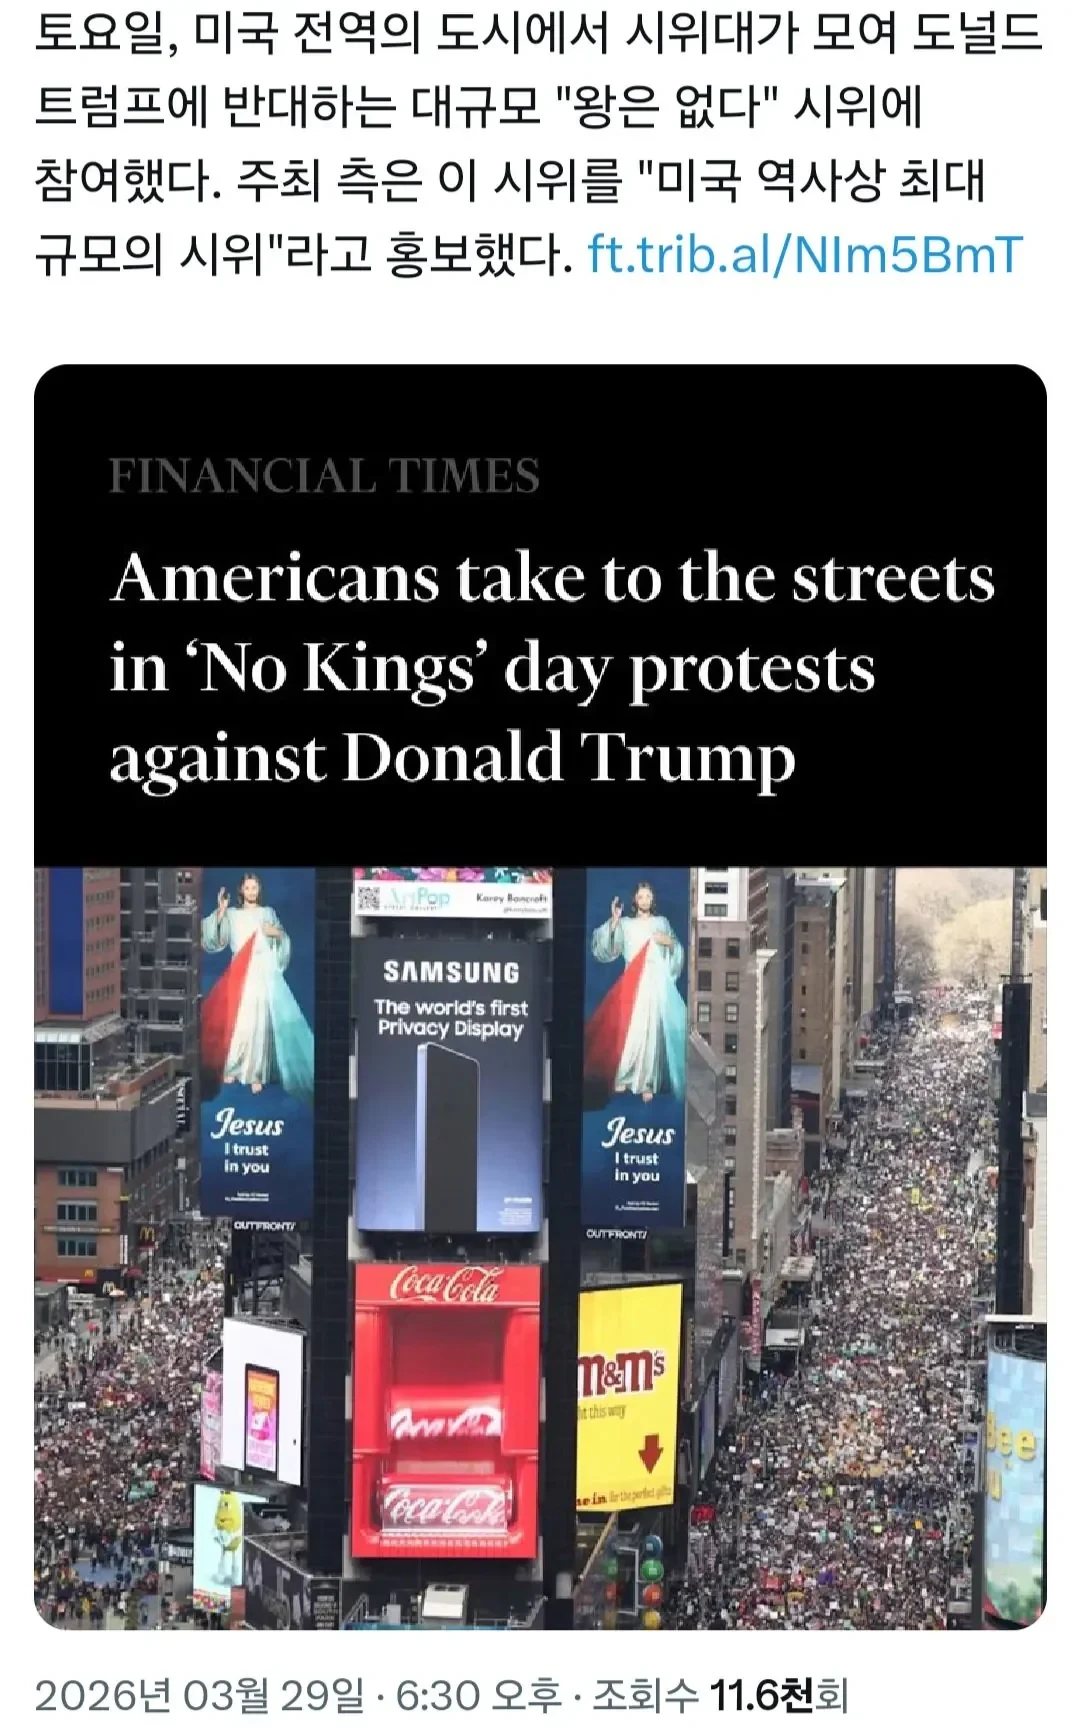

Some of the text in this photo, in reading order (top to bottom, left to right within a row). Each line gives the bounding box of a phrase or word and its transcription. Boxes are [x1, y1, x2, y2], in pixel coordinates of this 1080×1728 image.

[384, 960, 520, 983] SAMSUNG
[374, 999, 529, 1017] The world's first
[378, 1019, 525, 1042] Privacy Display
[210, 1107, 284, 1139] Jesus
[601, 1116, 676, 1149] Jesus
[225, 1142, 269, 1157] I trust
[615, 1151, 660, 1166] I trust
[224, 1159, 270, 1176] in you
[615, 1167, 660, 1185] in you
